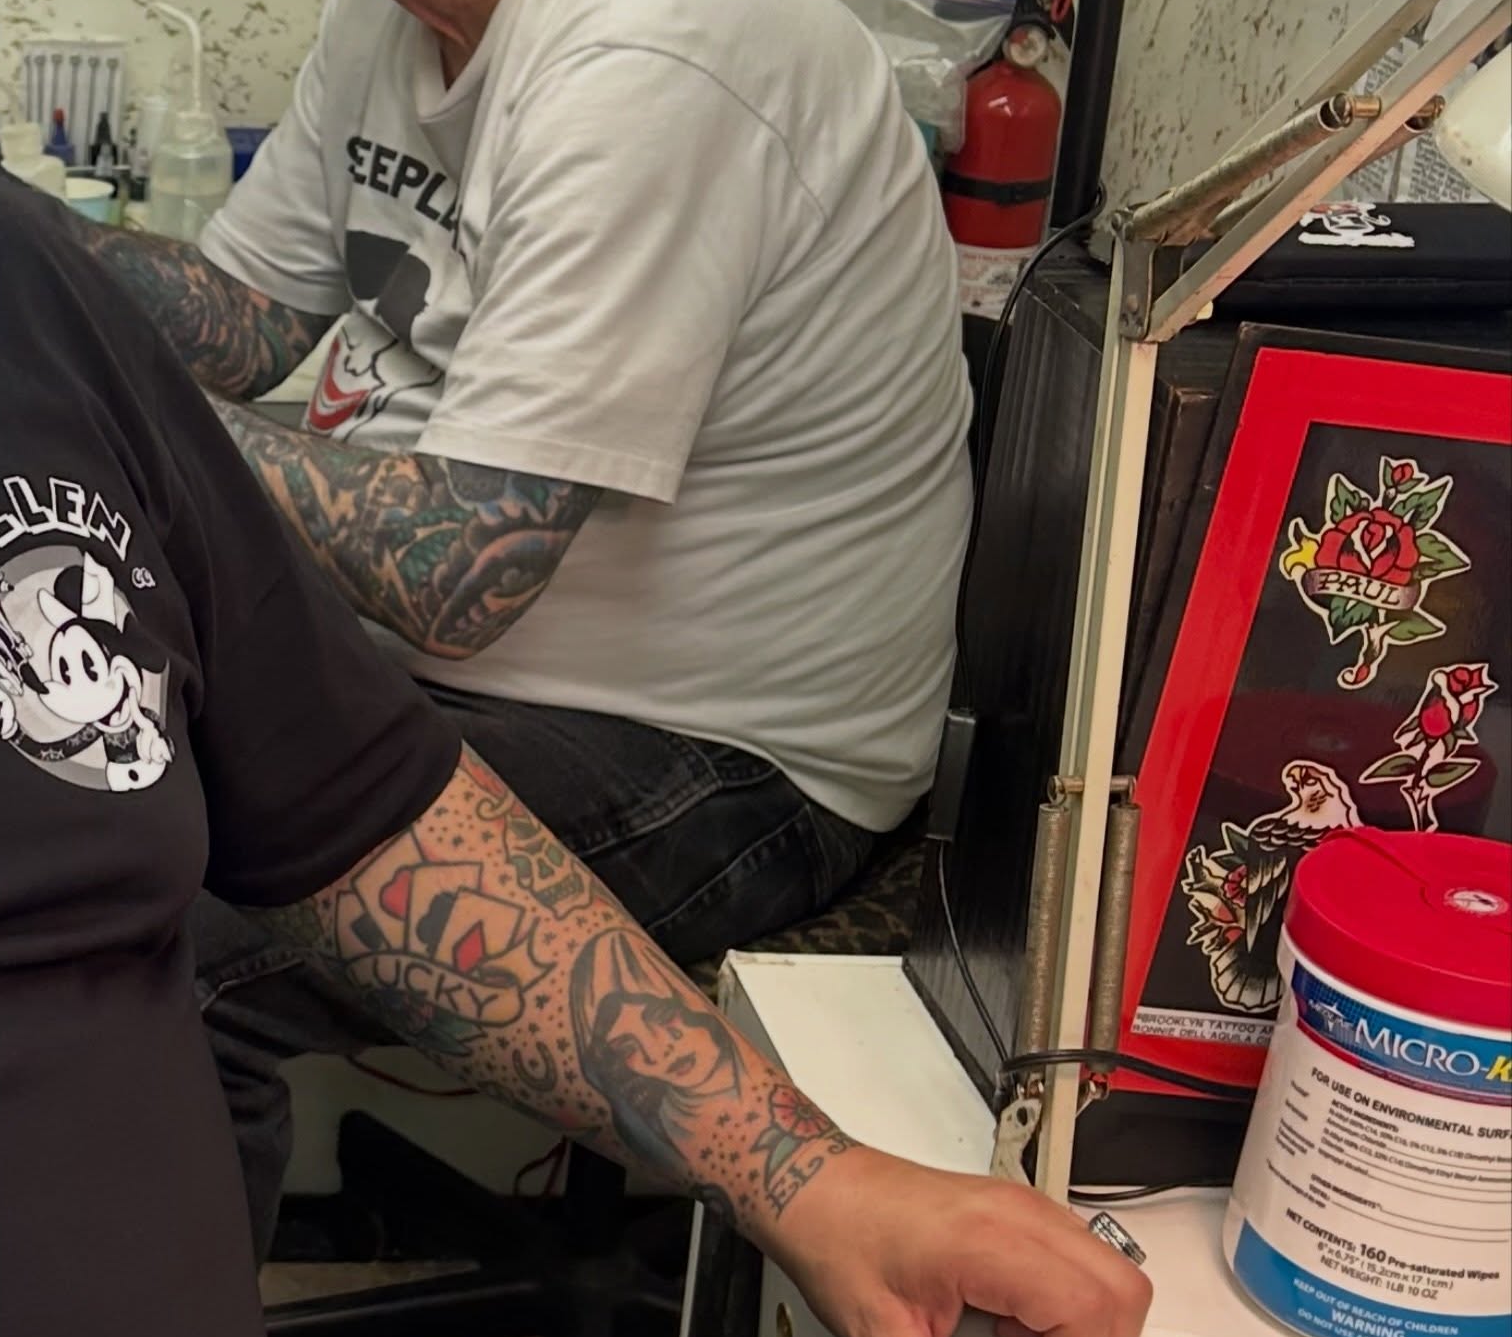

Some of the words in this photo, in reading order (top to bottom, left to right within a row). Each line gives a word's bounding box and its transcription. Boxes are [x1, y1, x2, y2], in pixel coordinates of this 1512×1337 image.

[1317, 571, 1402, 606] PAUL
[345, 957, 500, 1019] LUCKY
[1133, 1024, 1176, 1037] RONNIE
[1208, 1019, 1256, 1033] TATTOO
[1311, 1066, 1330, 1086] FOR
[1331, 1081, 1353, 1099] USE
[1354, 1092, 1370, 1107] ON
[1372, 1100, 1474, 1137] ENVIRONMENTAL
[1477, 1126, 1512, 1140] SURF
[1286, 1207, 1303, 1225] NET
[1303, 1217, 1357, 1253] CONTENTS:
[1359, 1243, 1386, 1263] 160
[1388, 1256, 1465, 1279] Pre-saturated
[1467, 1269, 1500, 1282] Wipes
[1320, 1254, 1339, 1271] NET
[1340, 1263, 1382, 1288] WEIGHT:
[1407, 1284, 1420, 1297] 10
[1420, 1287, 1439, 1301] OZ
[1293, 1277, 1316, 1295] KEEP
[1315, 1289, 1337, 1306] OUT
[1337, 1299, 1351, 1312] OF
[1387, 1316, 1403, 1328] OF
[1403, 1319, 1459, 1336] CHILDREN
[1313, 1315, 1334, 1330] NOT
